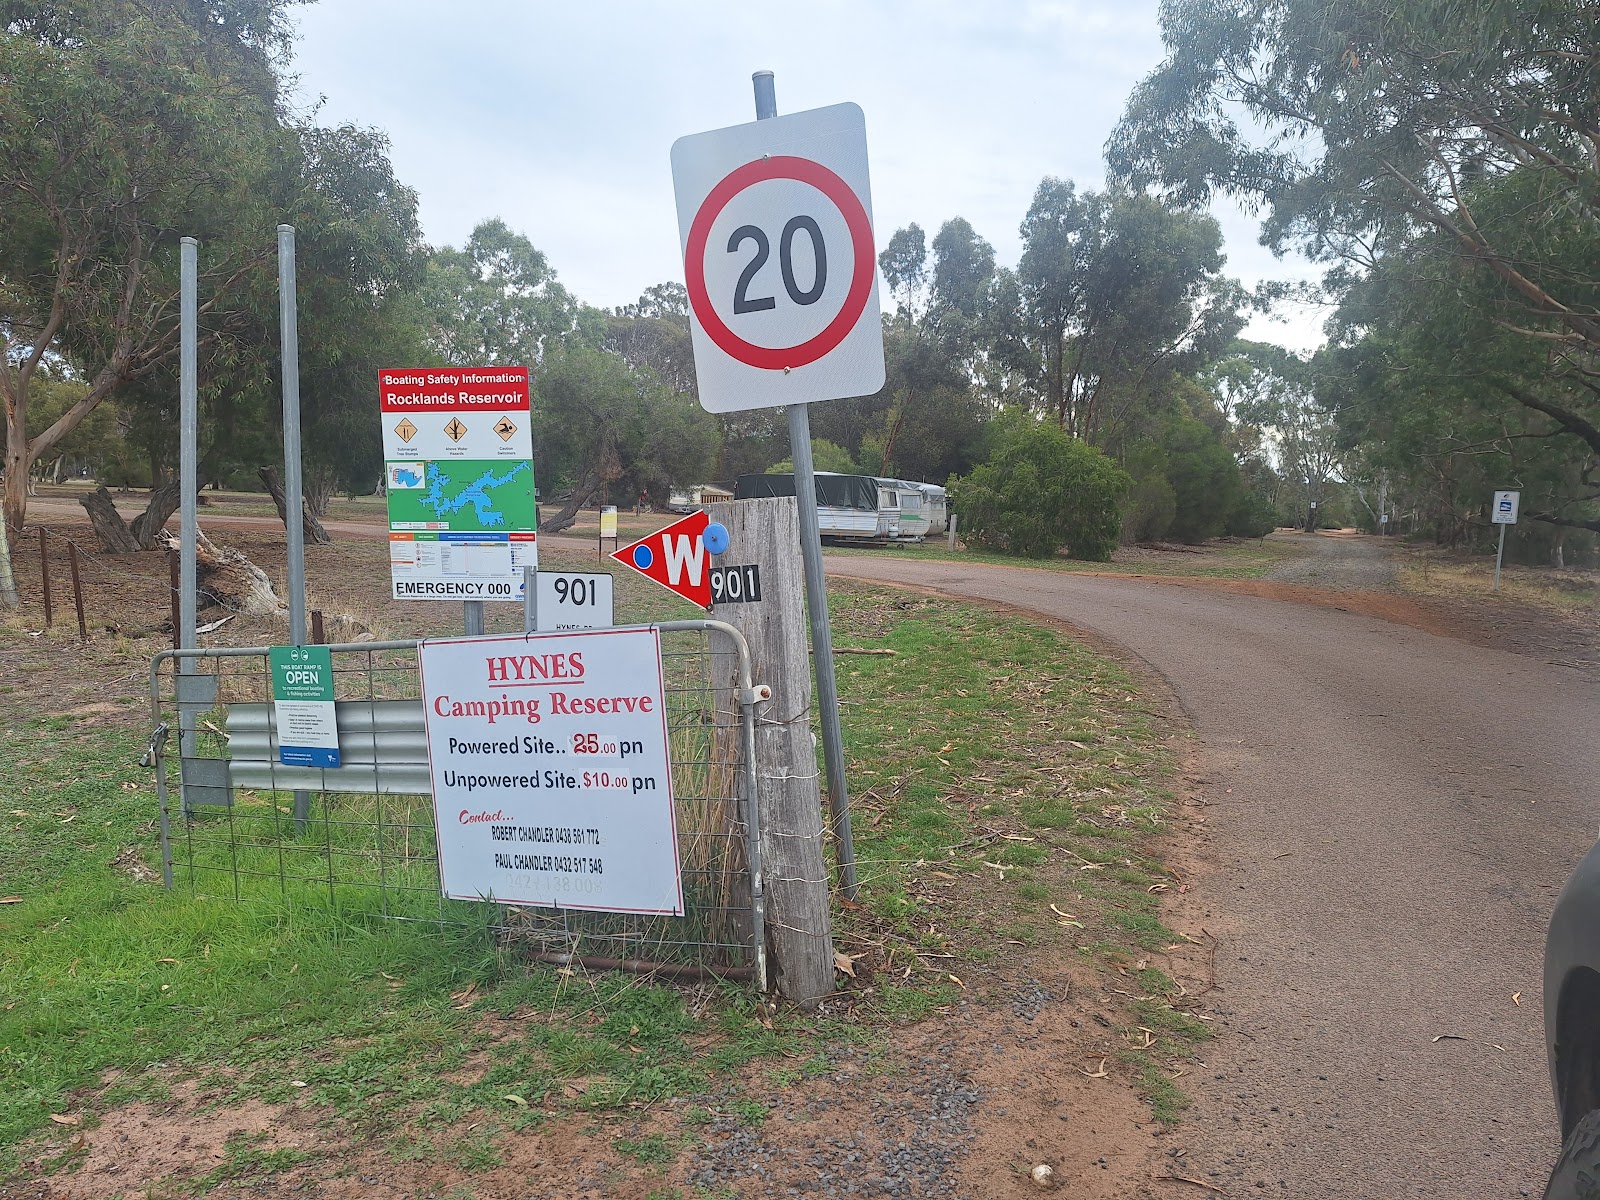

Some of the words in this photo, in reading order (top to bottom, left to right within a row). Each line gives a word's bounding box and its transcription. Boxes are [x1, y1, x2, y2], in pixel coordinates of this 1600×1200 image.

[727, 215, 827, 315] 20
[385, 375, 424, 386] Boating
[427, 374, 459, 386] Safety
[462, 373, 522, 384] Information
[387, 393, 455, 405] Rocklands
[459, 391, 522, 404] Reservoir
[661, 534, 705, 587] W
[396, 582, 484, 595] EMERGENCY
[488, 583, 511, 595] 000
[554, 577, 595, 606] 901
[711, 568, 755, 599] 901
[286, 671, 319, 684] OPEN
[486, 652, 585, 681] HYNES
[434, 693, 541, 724] Camping
[549, 692, 653, 715] Reserve
[450, 736, 519, 754] Powered
[523, 735, 566, 754] Site..
[619, 740, 643, 758] pn
[444, 770, 540, 792] Unpowered
[583, 771, 628, 788] $10.00
[632, 775, 656, 794] pn
[459, 809, 514, 825] Contact...
[491, 825, 517, 842] ROBERT
[518, 827, 554, 843] CHANDLER
[555, 828, 572, 844] 0438
[573, 829, 585, 845] 561
[586, 829, 600, 845] 772
[495, 853, 513, 870] PAUL
[514, 855, 553, 872] CHANDLER
[554, 856, 572, 873] 0432
[574, 858, 587, 873] 517
[589, 858, 603, 874] 548
